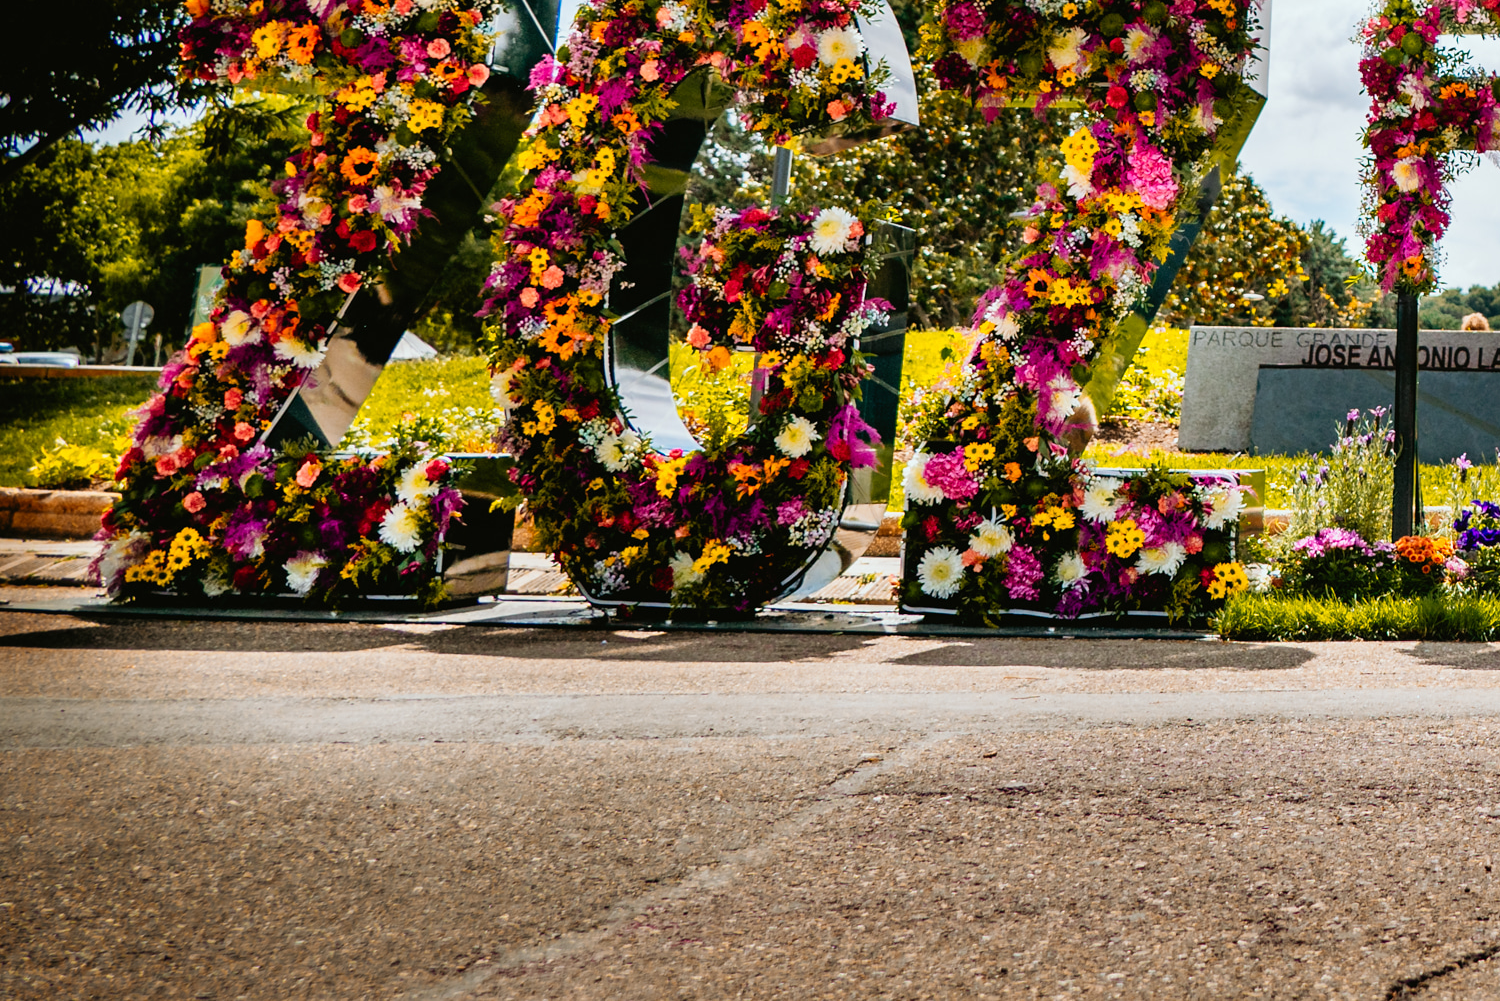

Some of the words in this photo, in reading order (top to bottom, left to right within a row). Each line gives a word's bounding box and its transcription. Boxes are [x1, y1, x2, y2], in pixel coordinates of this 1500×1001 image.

[1193, 331, 1283, 348] PARQUE
[1296, 333, 1388, 349] GRANDE
[1302, 344, 1361, 367] JOSE
[1367, 345, 1471, 369] ANONIO
